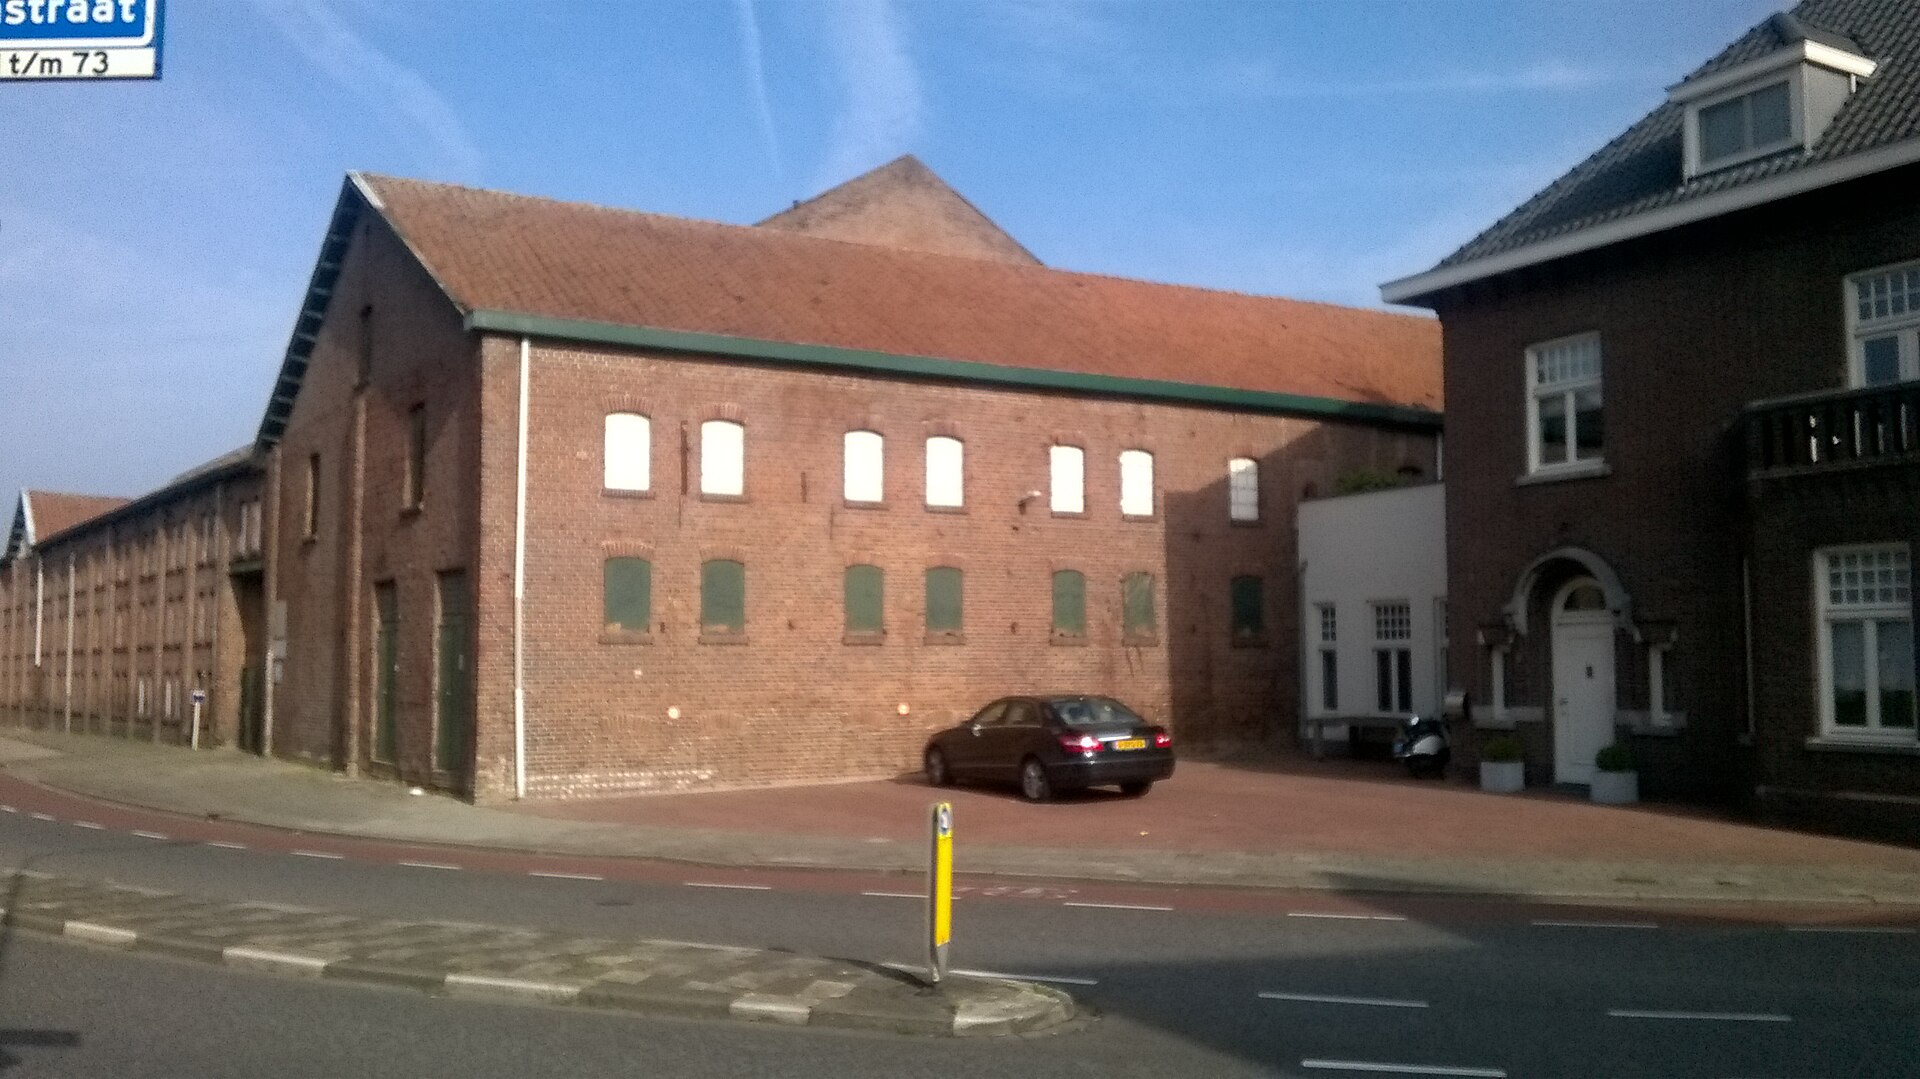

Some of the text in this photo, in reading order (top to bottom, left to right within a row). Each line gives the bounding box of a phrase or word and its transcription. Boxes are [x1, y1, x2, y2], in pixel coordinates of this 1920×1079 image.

[0, 0, 136, 25] straat
[9, 51, 109, 74] t/m 73
